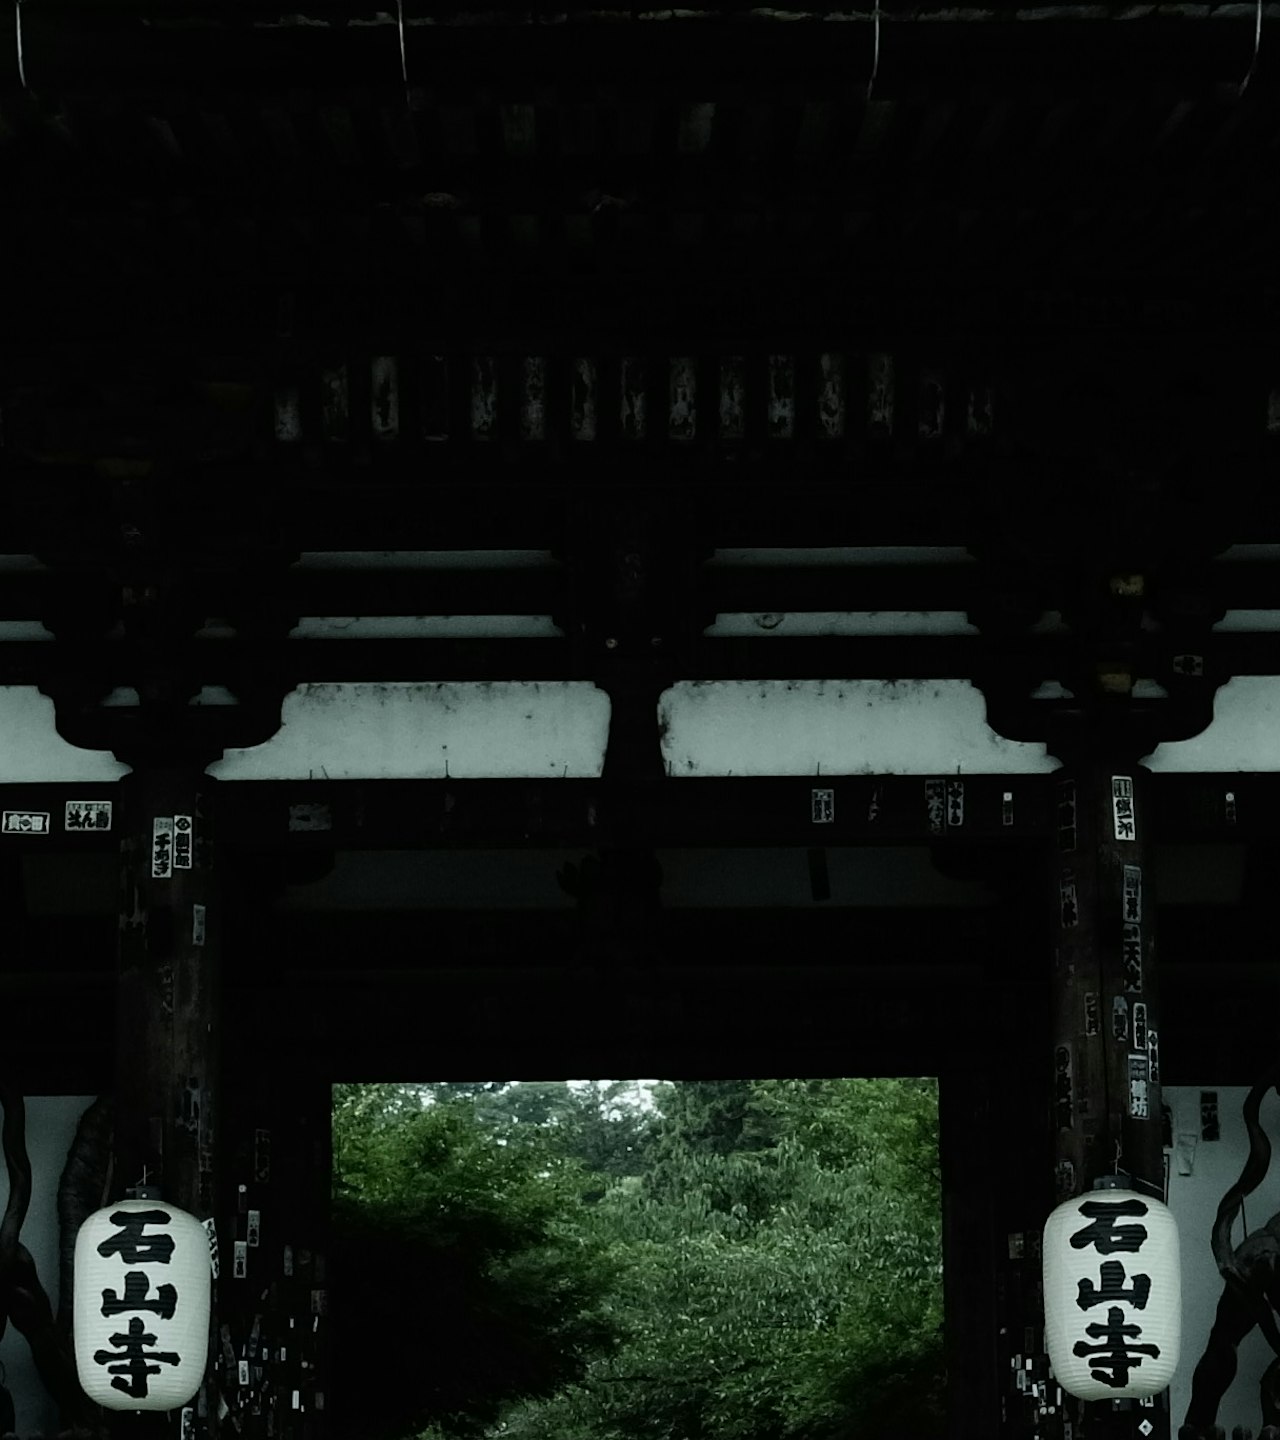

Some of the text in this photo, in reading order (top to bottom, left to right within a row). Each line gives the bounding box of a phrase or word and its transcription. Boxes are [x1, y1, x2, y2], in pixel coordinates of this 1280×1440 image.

[94, 1210, 181, 1398] 石山寺
[1070, 1199, 1160, 1388] 石山寺
